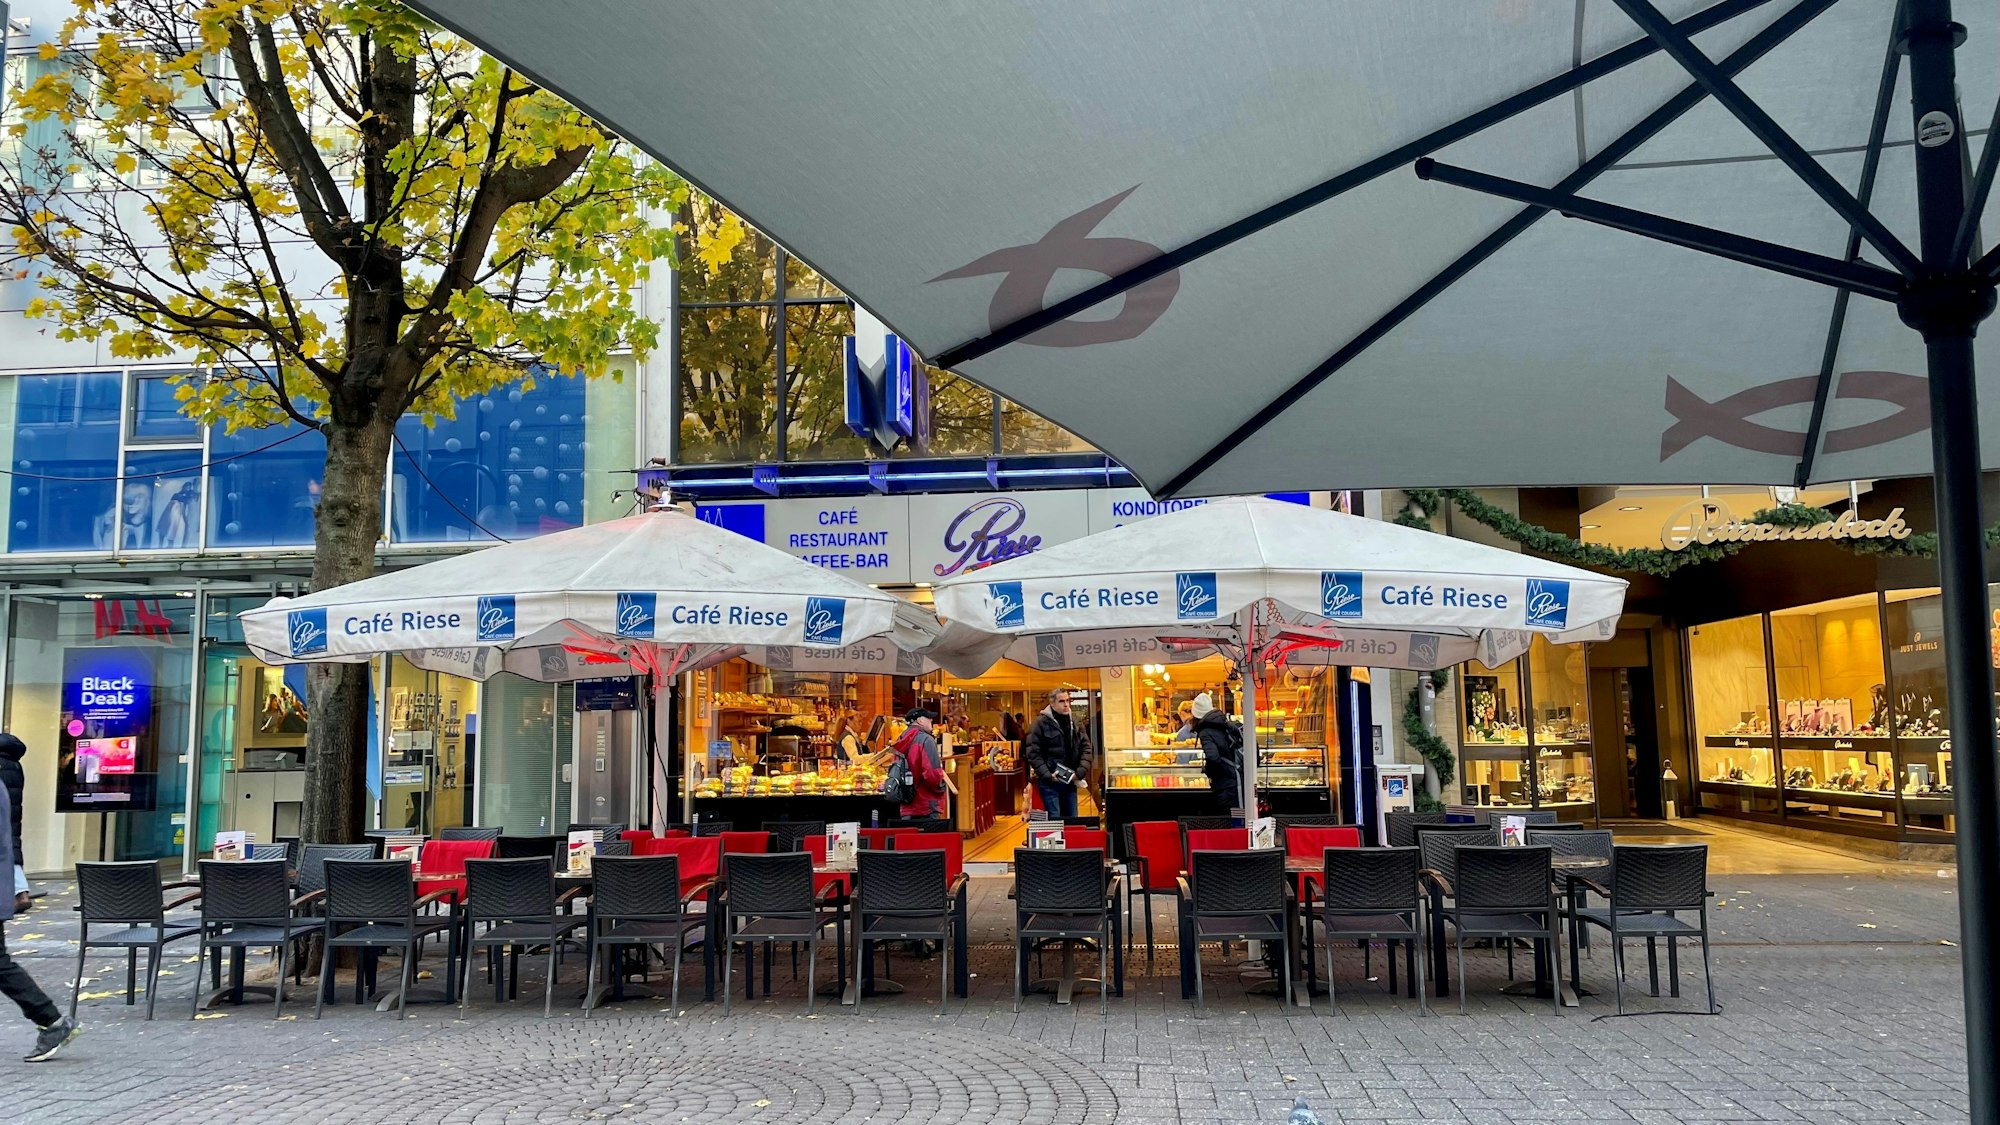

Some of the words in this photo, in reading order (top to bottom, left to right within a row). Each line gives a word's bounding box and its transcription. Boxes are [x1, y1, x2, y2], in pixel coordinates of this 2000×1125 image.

[818, 506, 858, 525] CAFÉ
[789, 531, 888, 547] RESTAURANT
[934, 497, 1042, 576] Riese
[796, 553, 889, 568] AFFEE-BAR
[1040, 588, 1090, 610] Café
[1097, 587, 1159, 606] Riese
[1381, 586, 1434, 605] Café
[1443, 587, 1508, 609] Riese
[344, 612, 394, 636] Café
[401, 610, 461, 631] Riese
[671, 604, 721, 625] Café
[728, 606, 788, 626] Riese
[82, 676, 134, 691] Black
[81, 691, 134, 705] Deals
